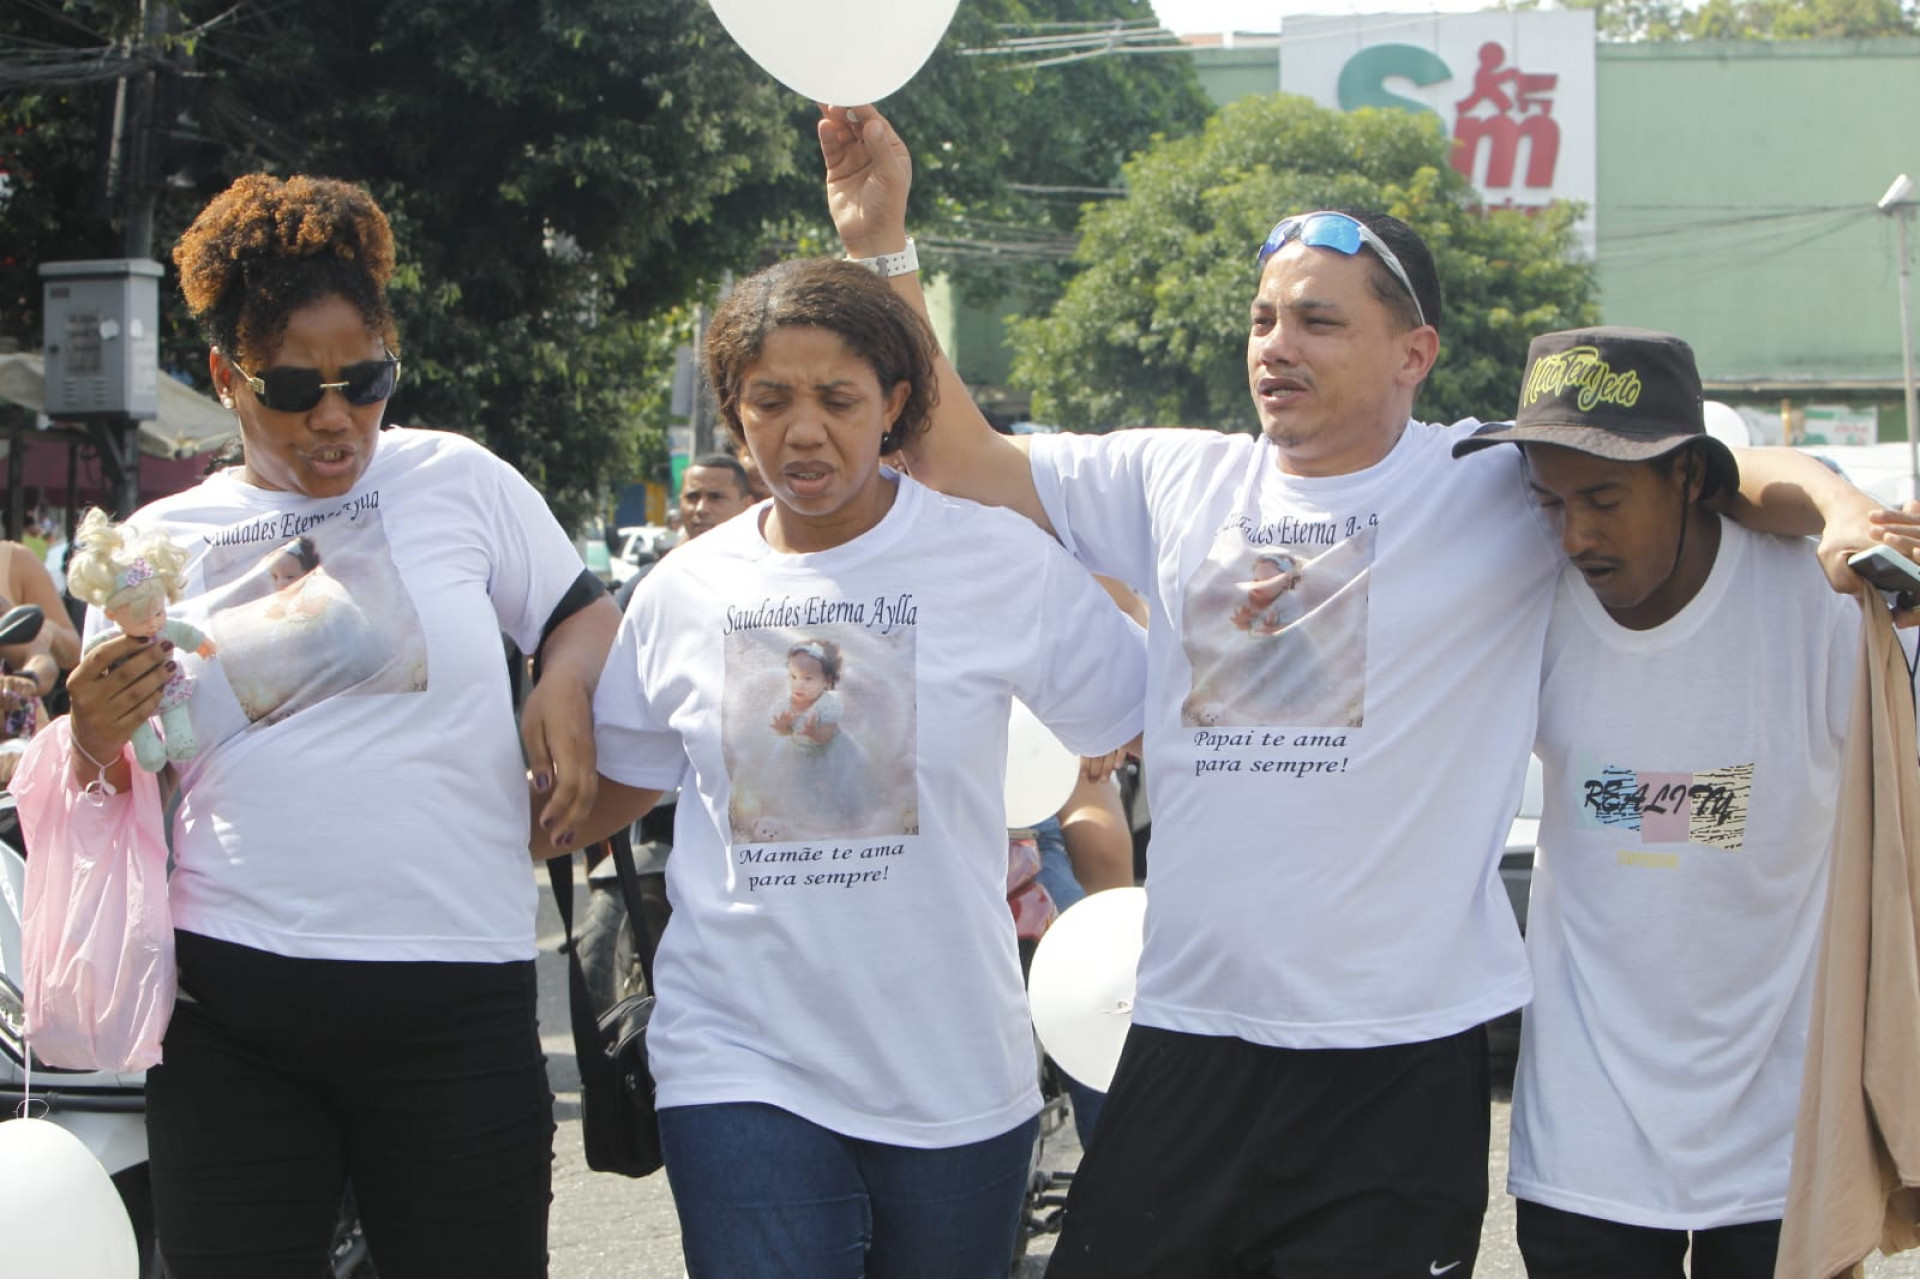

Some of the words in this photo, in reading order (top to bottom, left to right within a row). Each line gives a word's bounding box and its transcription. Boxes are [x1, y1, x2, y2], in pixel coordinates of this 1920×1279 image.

[281, 511, 334, 539] Etern
[1277, 515, 1337, 546] Eterna
[723, 595, 801, 636] Saudades
[804, 595, 865, 626] Eterna
[866, 593, 919, 635] Aylla
[1193, 729, 1255, 752] Papai
[1261, 732, 1286, 747] te
[1293, 734, 1348, 747] ama
[1195, 758, 1242, 777] para
[1250, 757, 1350, 778] sempre!
[739, 846, 824, 865] Mamãe
[831, 848, 853, 861] te
[859, 843, 906, 860] ama
[748, 872, 798, 892] para
[803, 864, 890, 889] sempre!
